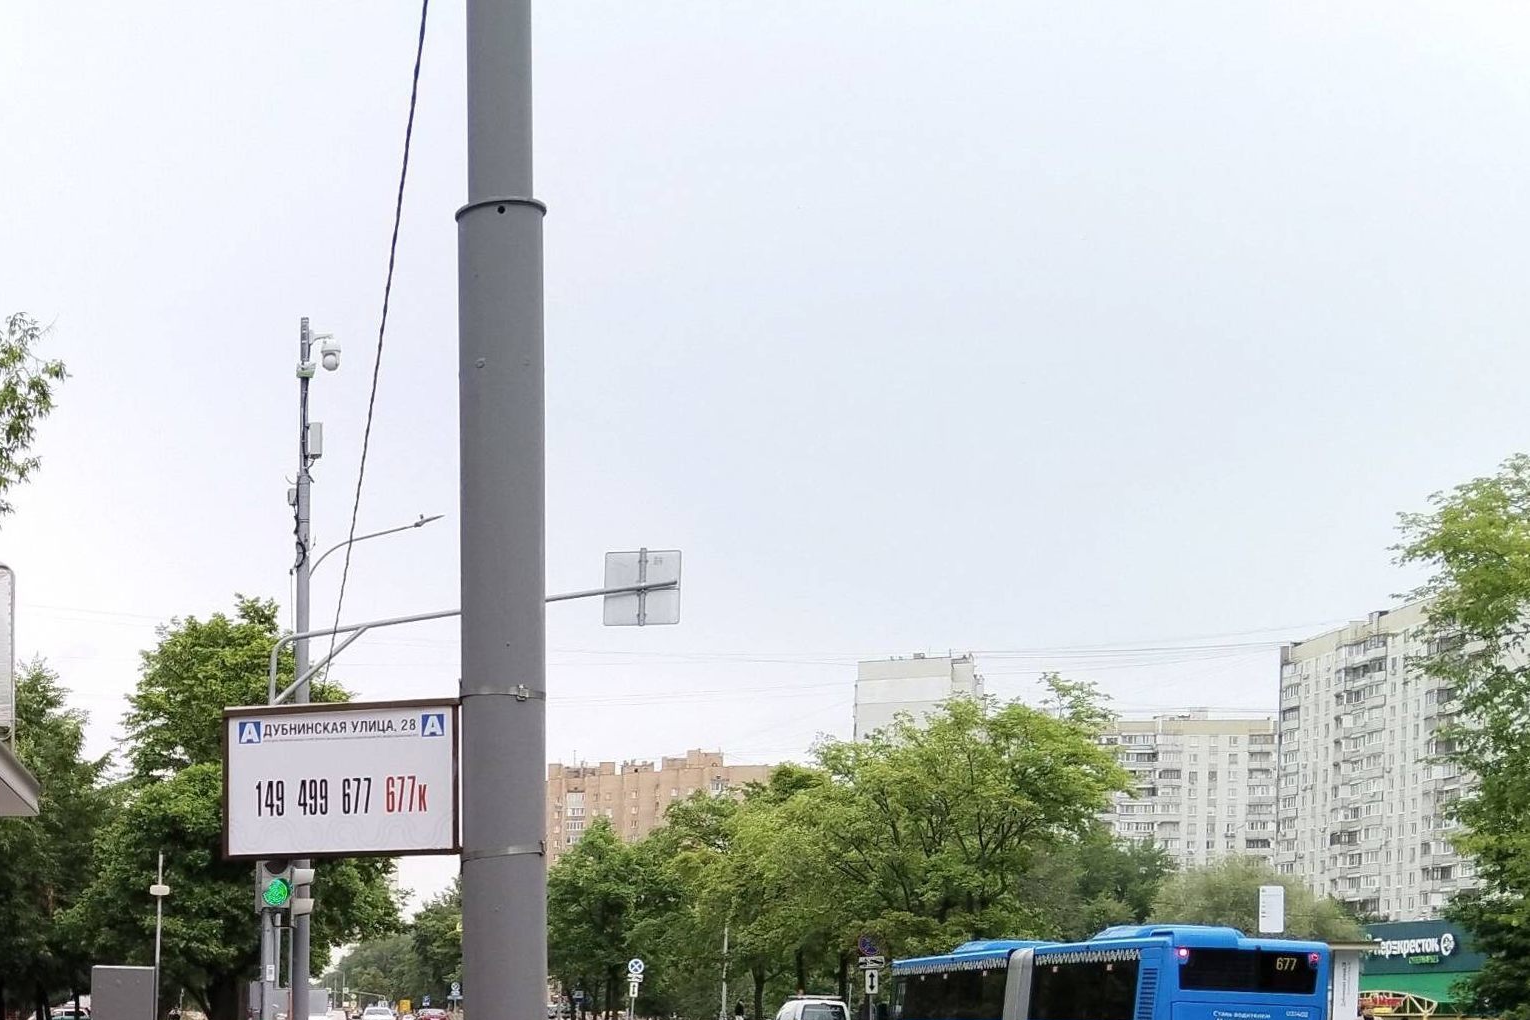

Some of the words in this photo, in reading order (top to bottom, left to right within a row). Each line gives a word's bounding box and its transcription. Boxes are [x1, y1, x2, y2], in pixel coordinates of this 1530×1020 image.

[263, 721, 346, 737] ДУБНИНСКАЯ
[401, 719, 416, 731] 28
[256, 781, 284, 816] 149
[298, 779, 328, 815] 499
[342, 778, 371, 814] 677
[386, 776, 427, 813] 677к
[1276, 957, 1297, 971] 677
